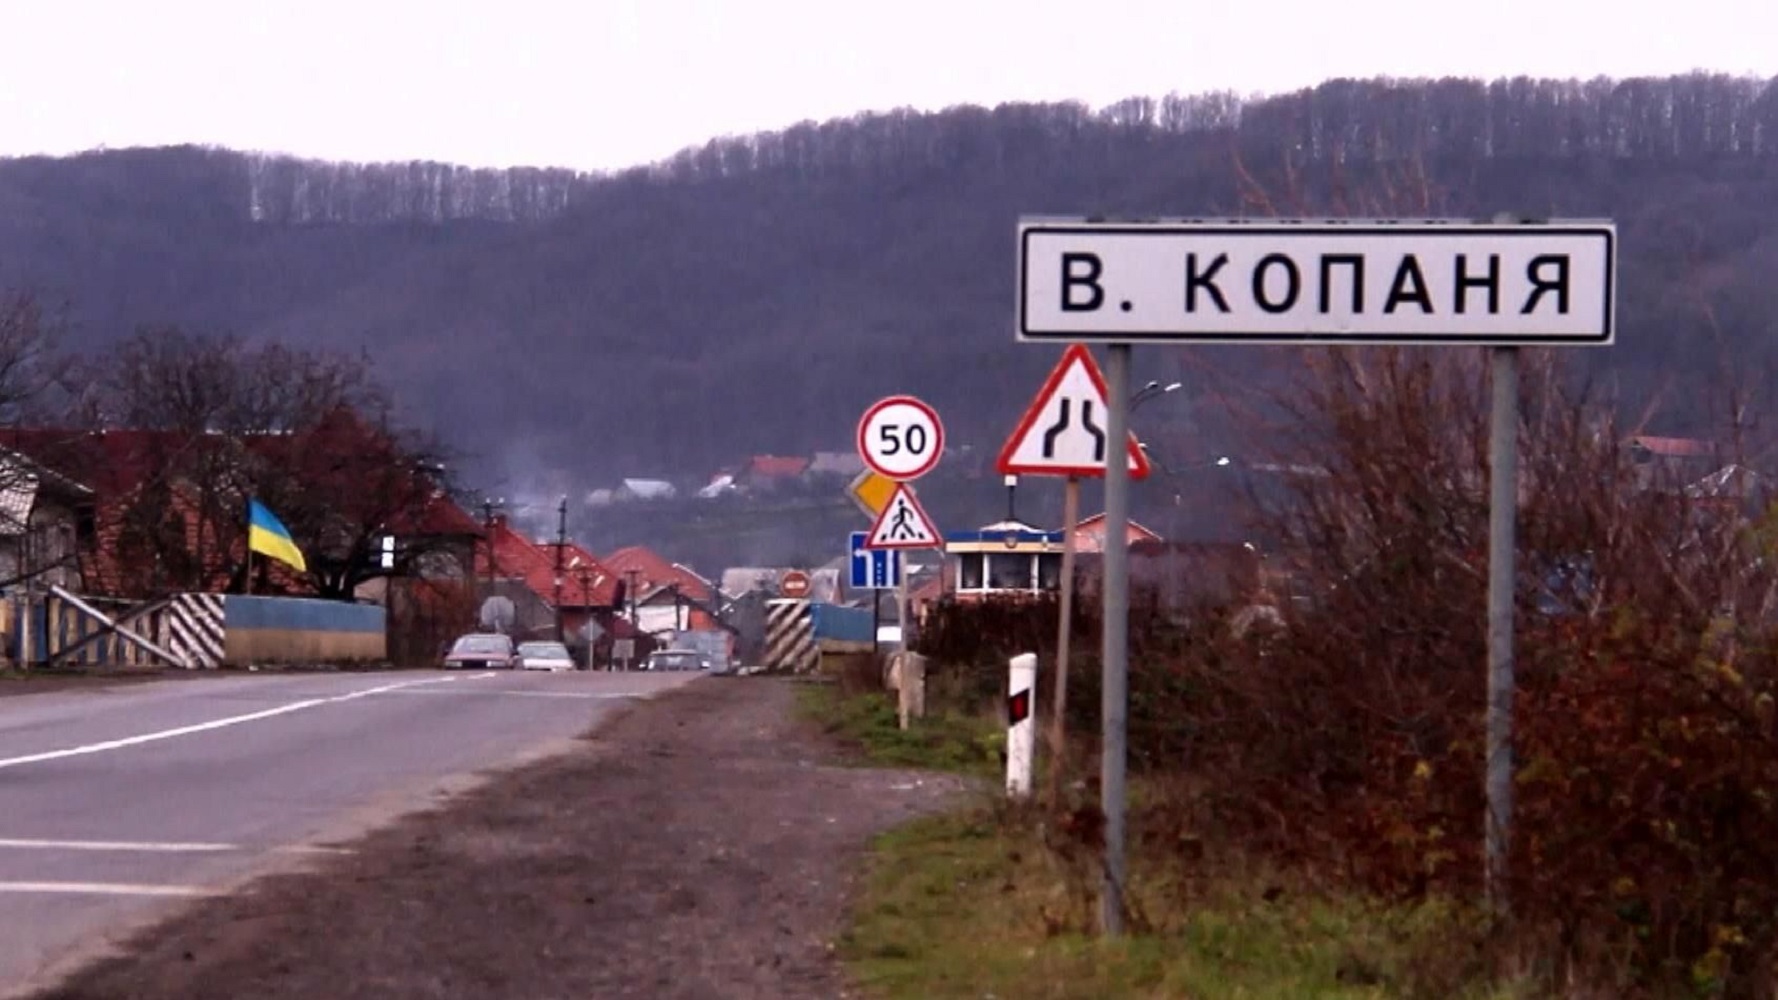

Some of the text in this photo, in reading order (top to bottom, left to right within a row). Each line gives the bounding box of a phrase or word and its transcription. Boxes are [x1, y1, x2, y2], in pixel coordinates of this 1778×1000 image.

[1060, 251, 1570, 315] В. КОПАНЯ
[880, 424, 926, 456] 50
